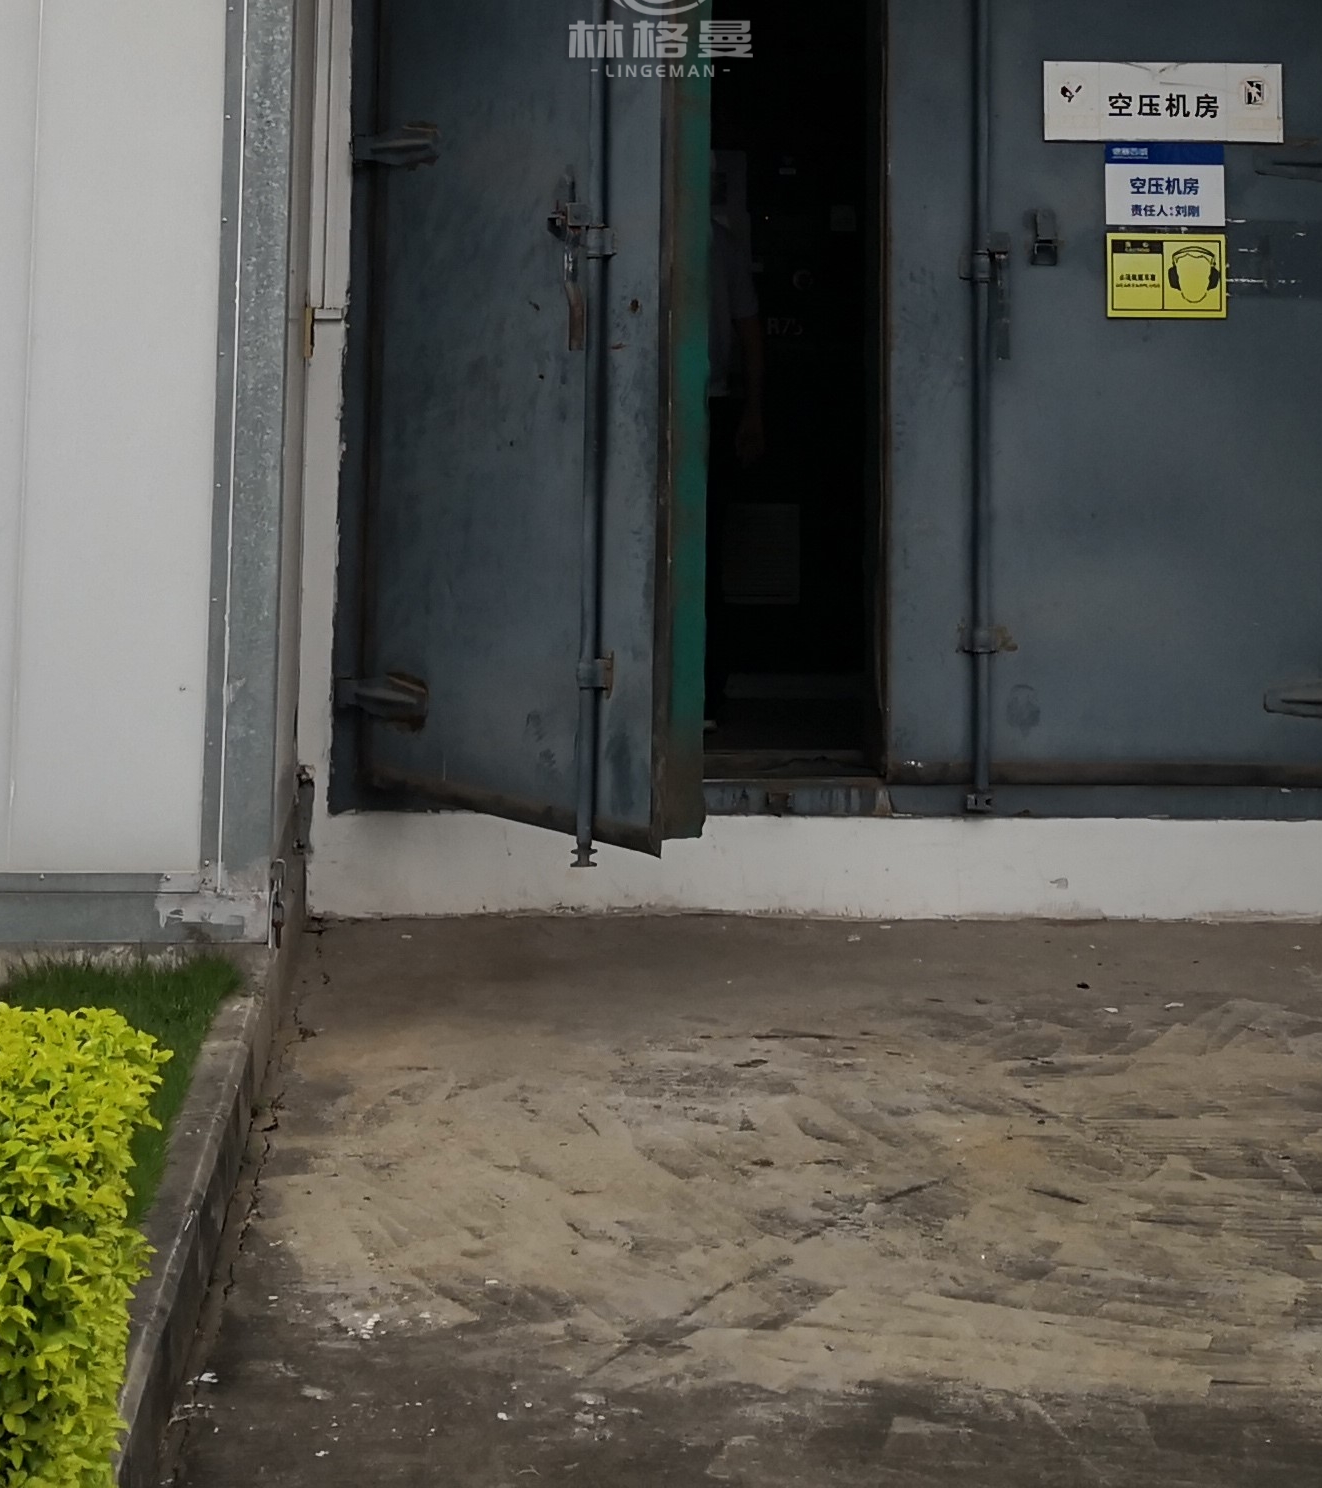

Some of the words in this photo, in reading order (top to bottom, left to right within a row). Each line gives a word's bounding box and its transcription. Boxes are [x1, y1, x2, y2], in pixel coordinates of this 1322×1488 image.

[1108, 92, 1219, 118] 空压机房
[1129, 176, 1200, 195] 空压机房
